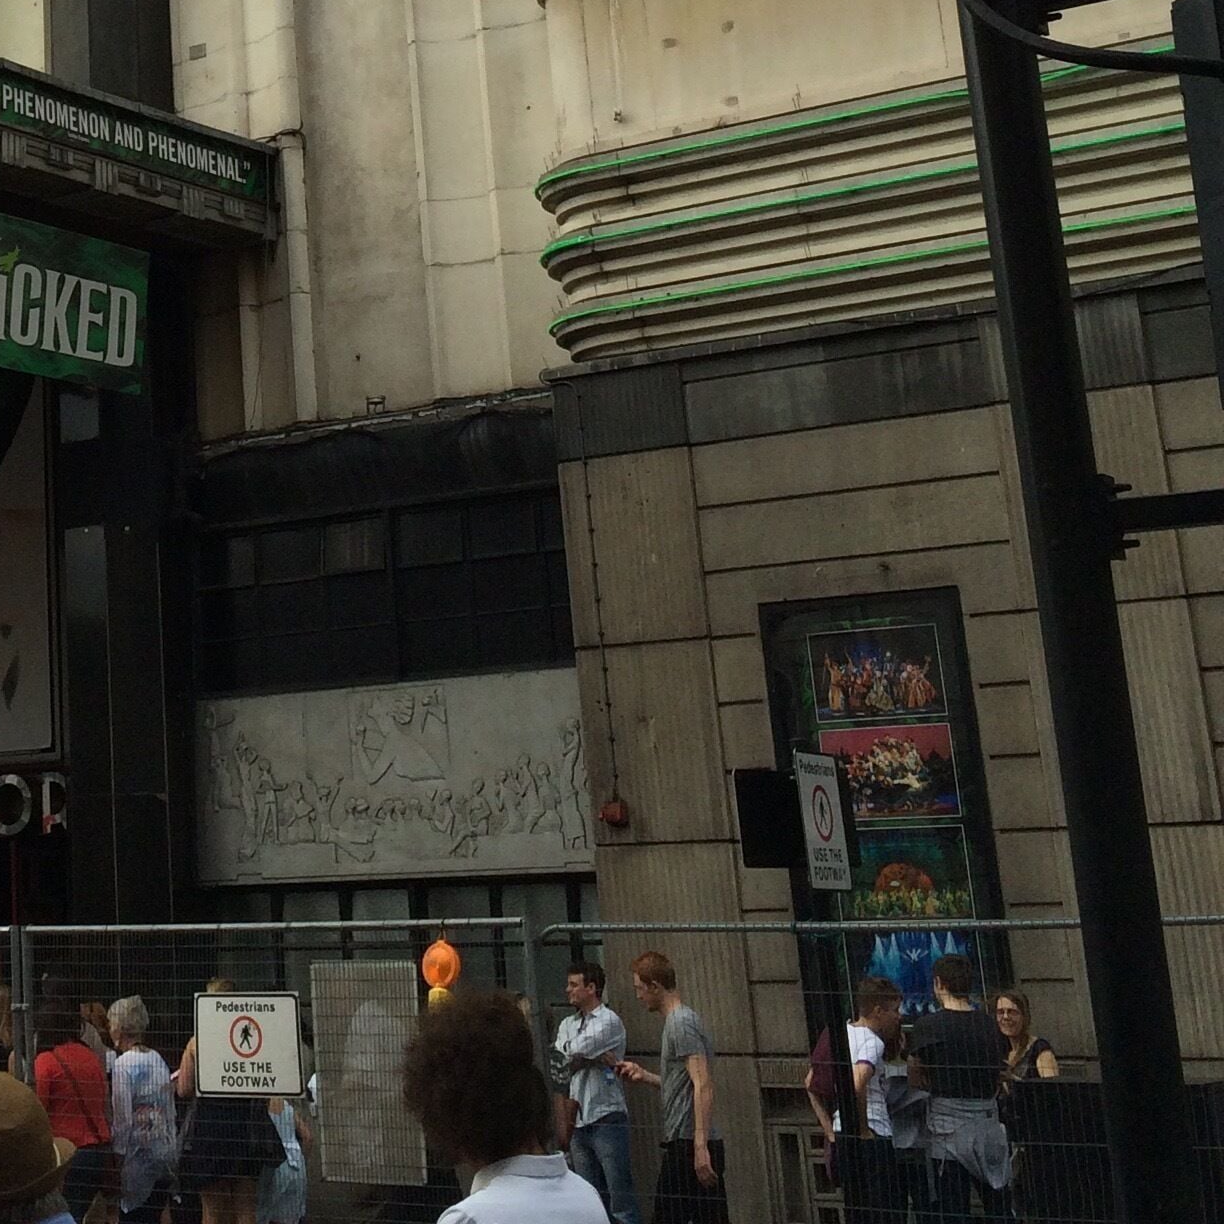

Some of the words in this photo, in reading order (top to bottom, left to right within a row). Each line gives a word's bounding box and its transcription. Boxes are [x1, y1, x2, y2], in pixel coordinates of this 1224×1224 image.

[1, 84, 111, 143] PHENOMENON
[113, 119, 144, 153] AND
[215, 1000, 276, 1013] Pedestrians
[223, 1061, 247, 1073] USE
[250, 1061, 273, 1074] THE
[221, 1075, 277, 1088] FOOTWAY
